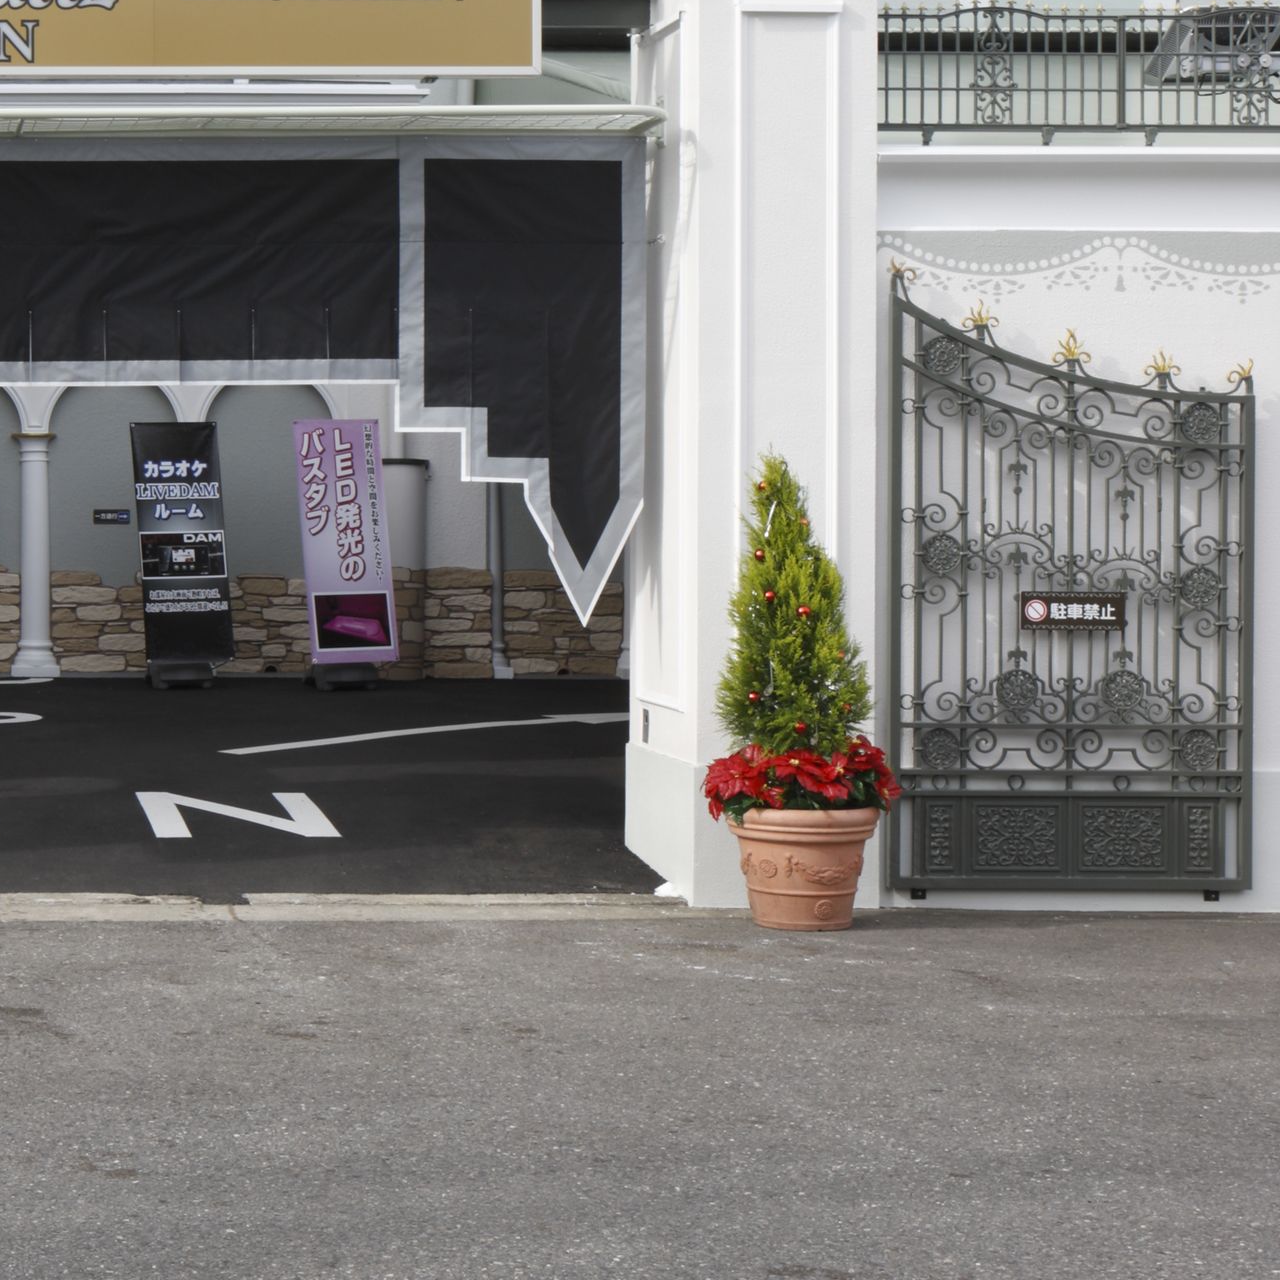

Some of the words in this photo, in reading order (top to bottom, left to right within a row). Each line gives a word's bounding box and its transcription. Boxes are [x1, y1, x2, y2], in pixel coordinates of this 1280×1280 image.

[143, 460, 208, 478] カラオケ
[136, 482, 220, 500] LIVEDAM
[300, 427, 331, 537] バスタブ
[154, 502, 205, 520] ルーム
[333, 427, 366, 582] LED発光の
[183, 532, 222, 543] DAM
[1049, 602, 1116, 620] 駐車禁止
